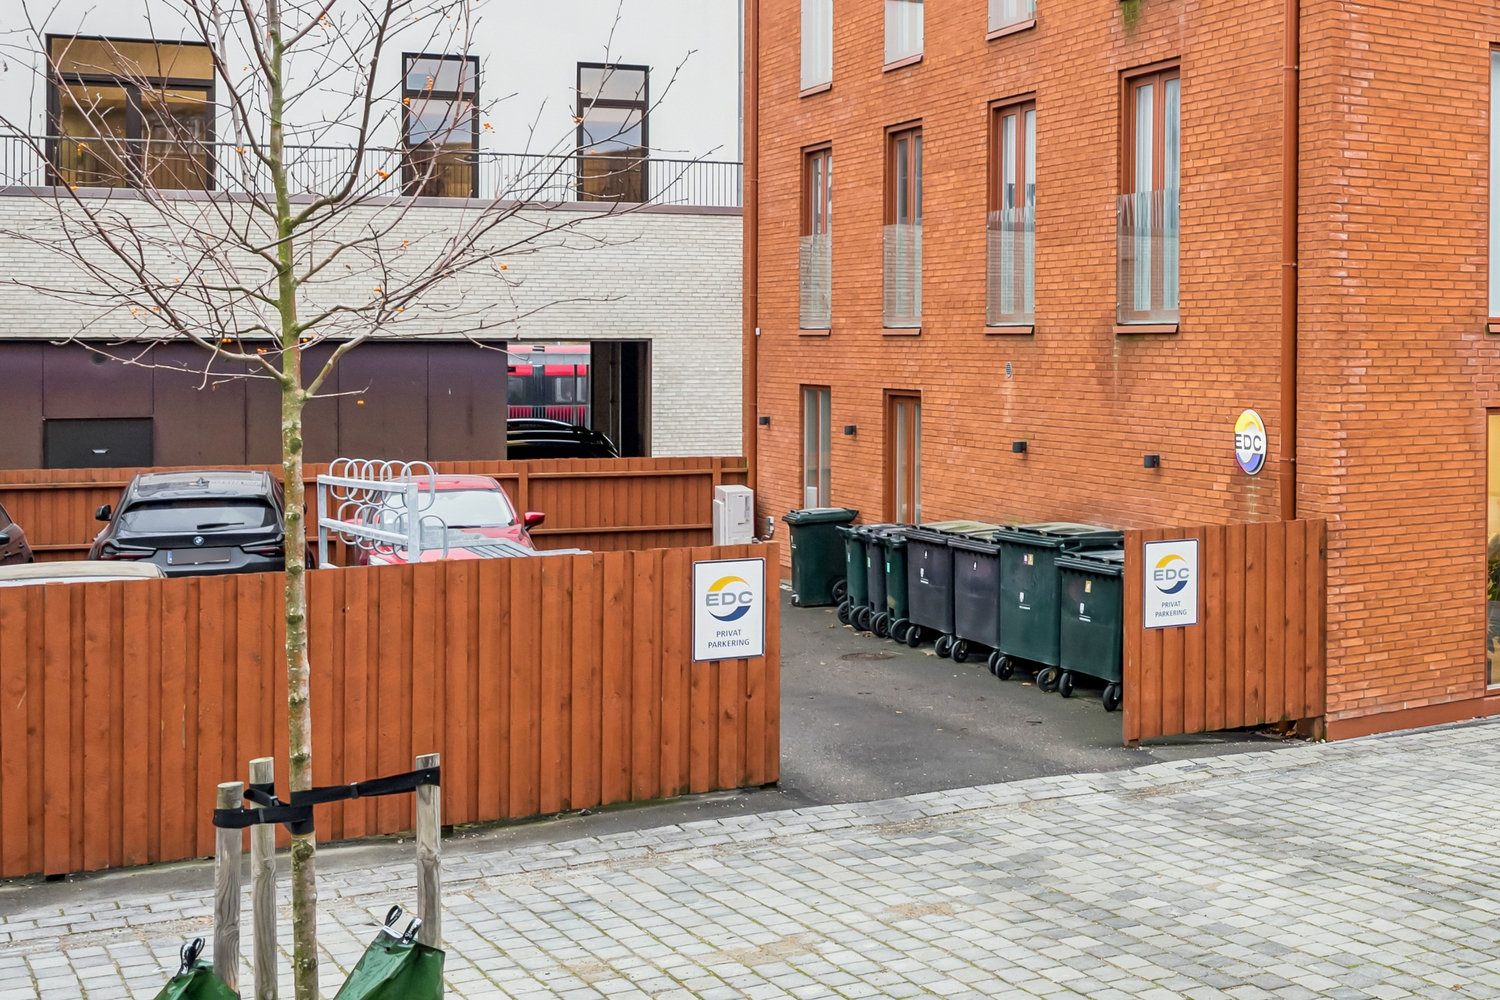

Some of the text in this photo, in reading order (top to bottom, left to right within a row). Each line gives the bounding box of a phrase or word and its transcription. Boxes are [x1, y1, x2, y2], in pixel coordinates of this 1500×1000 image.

[1234, 433, 1262, 451] EDC
[1153, 567, 1190, 581] EDC
[705, 591, 753, 607] EDC
[1161, 600, 1181, 608] PRIVAT
[1155, 608, 1187, 618] PARKERING
[716, 629, 742, 637] PRIVAT
[708, 638, 750, 648] PARKERING
